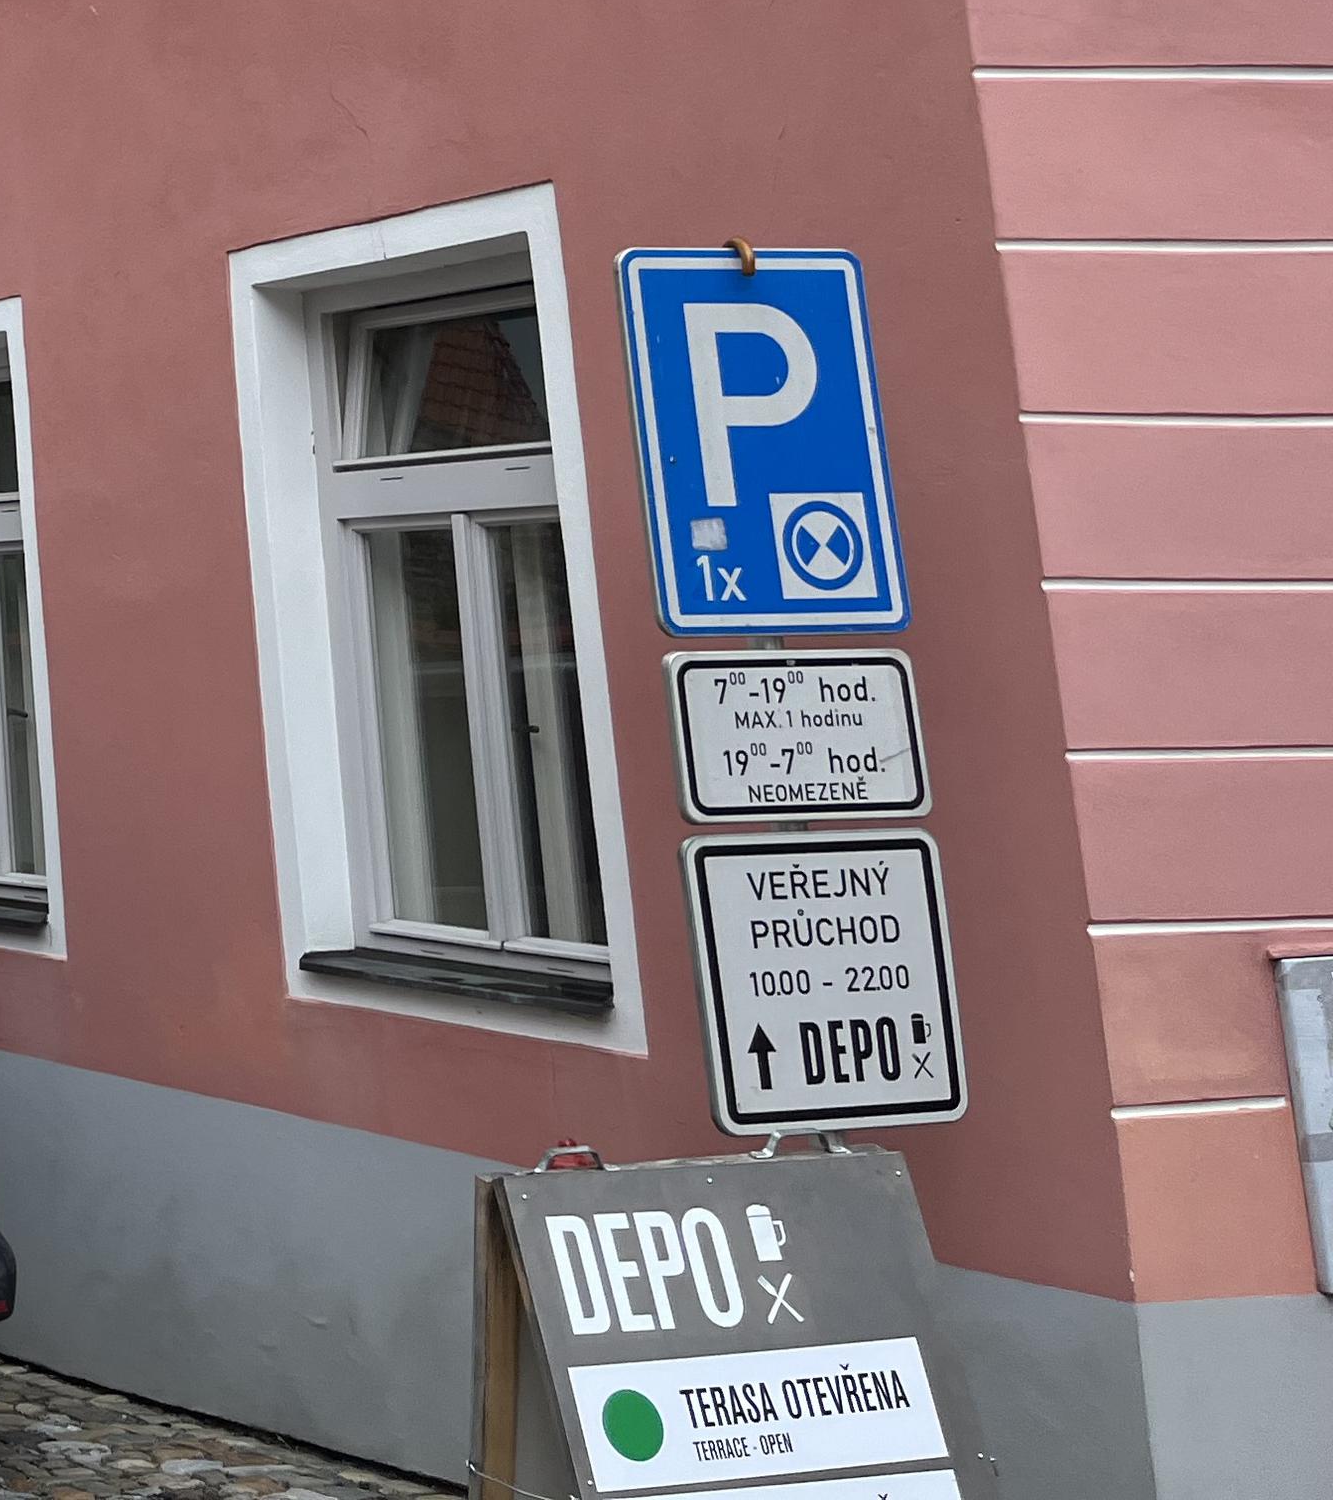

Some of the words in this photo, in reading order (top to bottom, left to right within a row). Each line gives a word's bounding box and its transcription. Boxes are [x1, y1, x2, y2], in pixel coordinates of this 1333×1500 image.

[683, 302, 818, 506] P
[696, 555, 746, 602] 1x
[818, 676, 876, 703] hod.
[735, 711, 782, 729] MAX.
[786, 710, 793, 727] 1
[801, 708, 863, 728] hodinu
[828, 746, 886, 774] hod.
[748, 776, 868, 803] NEOMEZENĚ
[746, 860, 889, 901] VEŘEJNÝ
[750, 909, 900, 949] PRŮCHOD
[749, 969, 811, 998] 10.00
[844, 964, 910, 993] 22.00
[799, 1016, 902, 1085] DEPO
[545, 1206, 744, 1336] DEPO
[679, 1381, 779, 1430] TERASA
[782, 1362, 911, 1422] OTEVŘENA
[693, 1436, 750, 1463] TERRACE
[759, 1432, 794, 1456] OPEN
